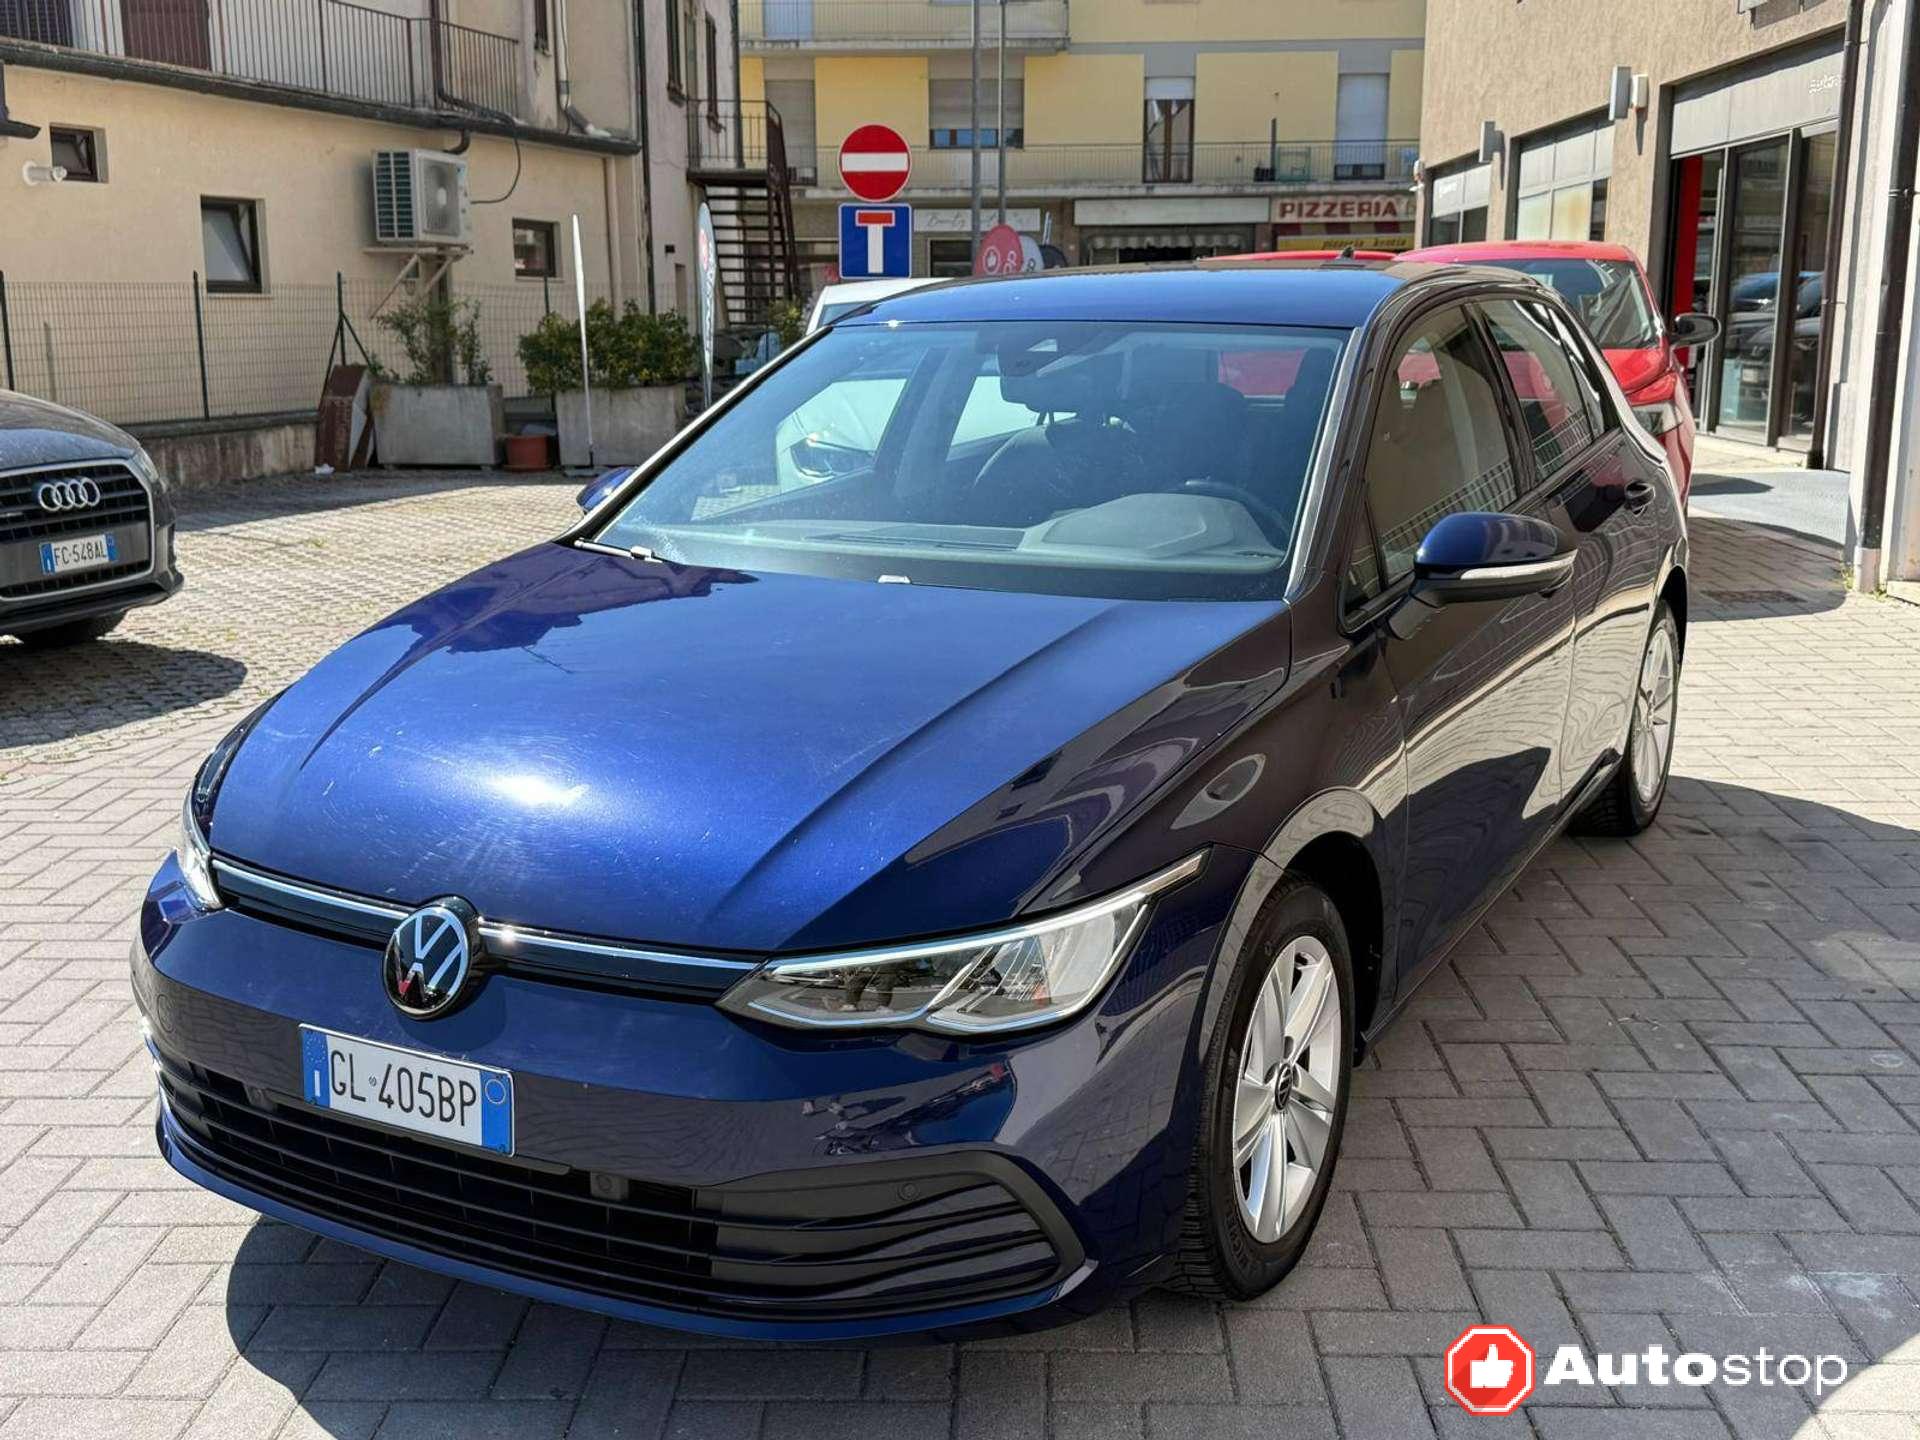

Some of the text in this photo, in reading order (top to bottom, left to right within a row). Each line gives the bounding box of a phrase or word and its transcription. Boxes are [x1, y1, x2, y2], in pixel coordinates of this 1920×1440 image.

[1279, 201, 1397, 218] PIZZERIA
[330, 1050, 477, 1127] GL 405BP
